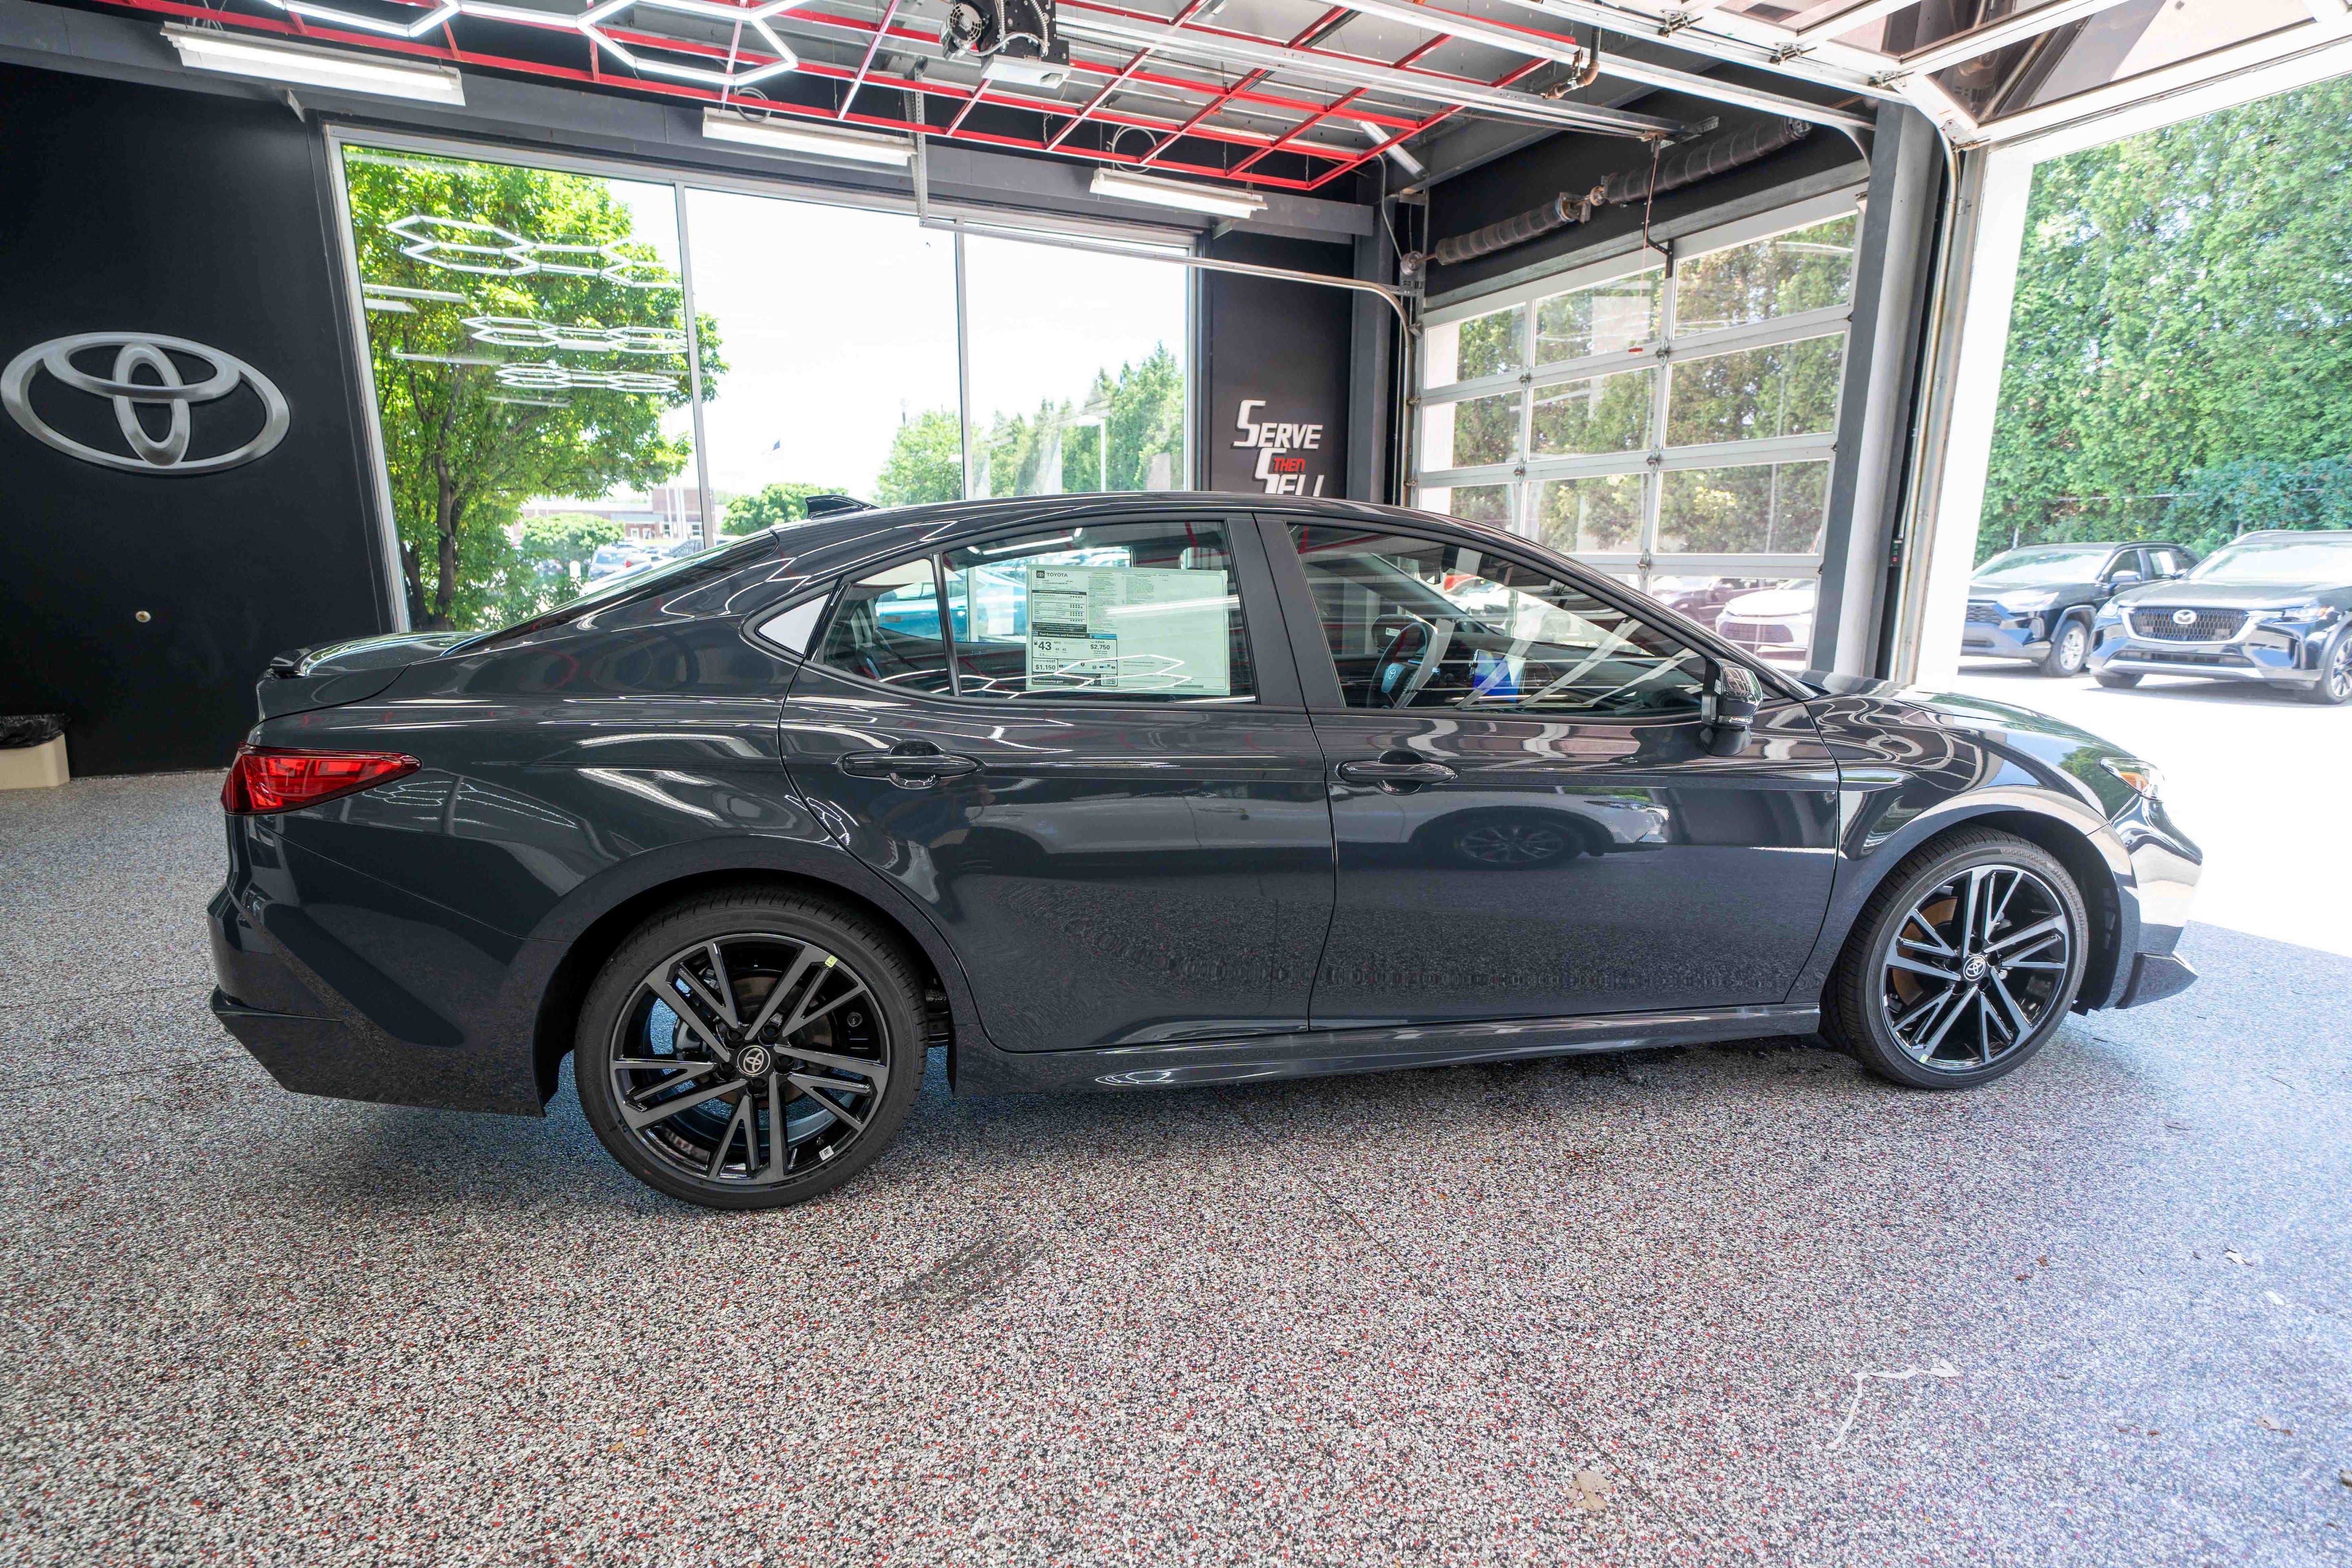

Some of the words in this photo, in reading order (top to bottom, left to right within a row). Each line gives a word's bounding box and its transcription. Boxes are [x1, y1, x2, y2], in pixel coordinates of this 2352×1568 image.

[1233, 399, 1323, 449] SERVE
[1274, 457, 1305, 472] THEN
[1038, 641, 1051, 650] 43
